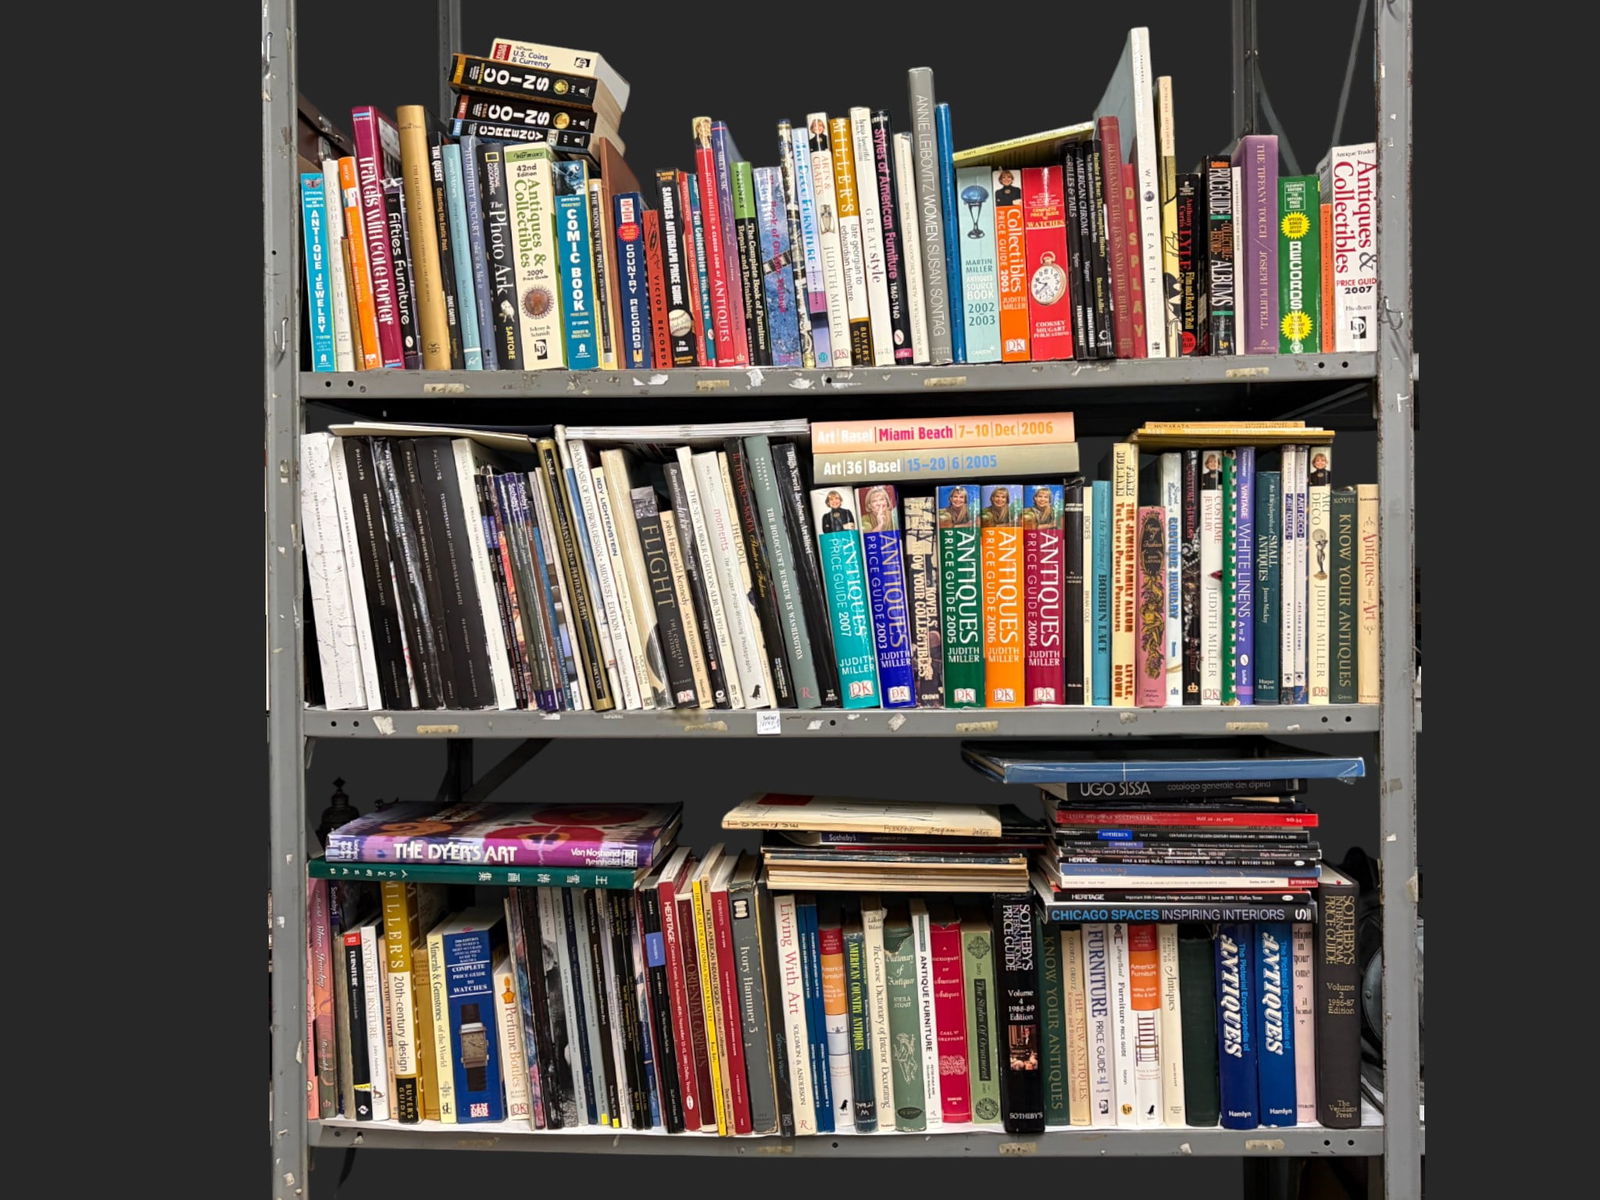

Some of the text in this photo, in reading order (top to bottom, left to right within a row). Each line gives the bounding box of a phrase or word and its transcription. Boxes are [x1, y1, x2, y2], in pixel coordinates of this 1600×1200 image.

[483, 67, 549, 92] COINS
[519, 58, 551, 68] Currency
[528, 52, 548, 60] Coins
[479, 125, 544, 141] CURRENCY
[488, 105, 550, 125] COINS
[874, 129, 888, 160] Styles
[516, 164, 537, 172] 42nd
[833, 119, 854, 212] MILLER'S
[878, 161, 889, 174] of
[514, 179, 530, 269] Collectibles
[527, 179, 546, 266] Antiques &
[880, 176, 893, 229] American
[916, 95, 946, 336] ANNIE LEIBOVITZ WOMEN SUSAN SONTAG
[1027, 220, 1065, 228] WATCHES
[1333, 162, 1356, 273] Collectibles
[1352, 160, 1377, 272] Antiques &
[311, 209, 322, 270] ANTIQUE
[389, 212, 410, 325] Fifties Furniture
[489, 201, 514, 296] The Photo Ark
[566, 209, 585, 311] COMIC BOOK
[841, 226, 854, 301] edwardian furniture
[851, 241, 861, 275] georgian
[856, 277, 862, 285] to
[885, 232, 899, 279] Furniture
[998, 211, 1009, 292] PRICE GUIDE 2005
[1007, 208, 1025, 293] Collectibles
[1125, 187, 1144, 338] DISPLAY
[315, 274, 325, 333] JEWELRY
[626, 244, 641, 349] COUNTRY RECORDS
[967, 283, 993, 291] SOURCE
[968, 291, 994, 300] BOOK
[968, 303, 995, 313] 2002
[1211, 259, 1233, 307] ALBUMS
[1289, 241, 1303, 310] RECORDS
[1344, 286, 1373, 294] 2007
[505, 326, 516, 360] SARTORE
[714, 280, 729, 342] ANTIQUES
[969, 316, 996, 326] 2003
[817, 430, 836, 444] Art
[841, 428, 873, 443] Basel
[879, 427, 914, 442] Miami
[918, 425, 953, 440] Beach
[995, 422, 1015, 436] Dec
[1021, 421, 1053, 435] 2006
[823, 462, 842, 475] Art
[847, 461, 862, 474] 36
[868, 458, 901, 473] Basel
[952, 457, 959, 469] 6
[967, 455, 997, 468] 2005
[596, 477, 618, 557] ROY LICHTENSTEIN
[642, 524, 676, 609] FLIGHT
[829, 539, 852, 637] PRICE GUIDE 2007
[842, 537, 867, 636] ANTIQUES
[867, 536, 888, 649] PRICE GUIDE 2003
[880, 534, 905, 648] ANTIQUES
[944, 530, 956, 644] PRICE GUIDE 2005
[957, 530, 979, 644] ANTIQUES
[985, 530, 996, 644] PRICE GUIDE 2006
[996, 531, 1018, 644] ANTIQUES
[1027, 533, 1038, 647] PRICE GUIDE 2004
[1037, 532, 1060, 648] ANTIQUES
[1239, 523, 1251, 617] WHITE LINENS
[1338, 513, 1352, 687] KNOW YOUR ANTIQUES
[880, 651, 911, 660] JUDITH
[881, 659, 911, 669] MILLER
[947, 647, 980, 655] JUDITH
[948, 655, 980, 663] MILLER
[1028, 650, 1060, 659] JUDITH
[1029, 658, 1060, 667] MILLER
[1080, 781, 1151, 796] UGO SISSA
[393, 840, 517, 865] THE DYER'S ART
[664, 902, 675, 943] HERITAGE
[1003, 905, 1016, 971] PRICE GUIDE
[1052, 908, 1285, 921] CHICAGO SPACES INSPIRING INTERIORS
[430, 942, 442, 1021] Minerals & Gemstones
[452, 964, 485, 972] COMPLETE
[453, 985, 488, 993] WATCHES
[740, 946, 757, 1025] Ivory Hammer
[780, 904, 801, 1014] Living With Art
[1088, 930, 1107, 1018] FURNITURE
[394, 976, 408, 1072] 20th-century design
[849, 942, 864, 1051] AMERICAN COUNTRY ANTIQUES
[920, 956, 933, 1052] ANTIQUE FURNITURE
[1008, 989, 1034, 997] Volume
[1009, 1013, 1033, 1021] Edition
[1044, 937, 1063, 1109] KNOW YOUR ANTIQUES
[1220, 934, 1243, 1058] ANTIQUES
[1261, 932, 1283, 1056] ANTIQUES
[505, 1006, 520, 1088] Perfume Bottles
[1228, 1110, 1251, 1118] Hamlyn
[1269, 1108, 1292, 1116] Hamlyn
